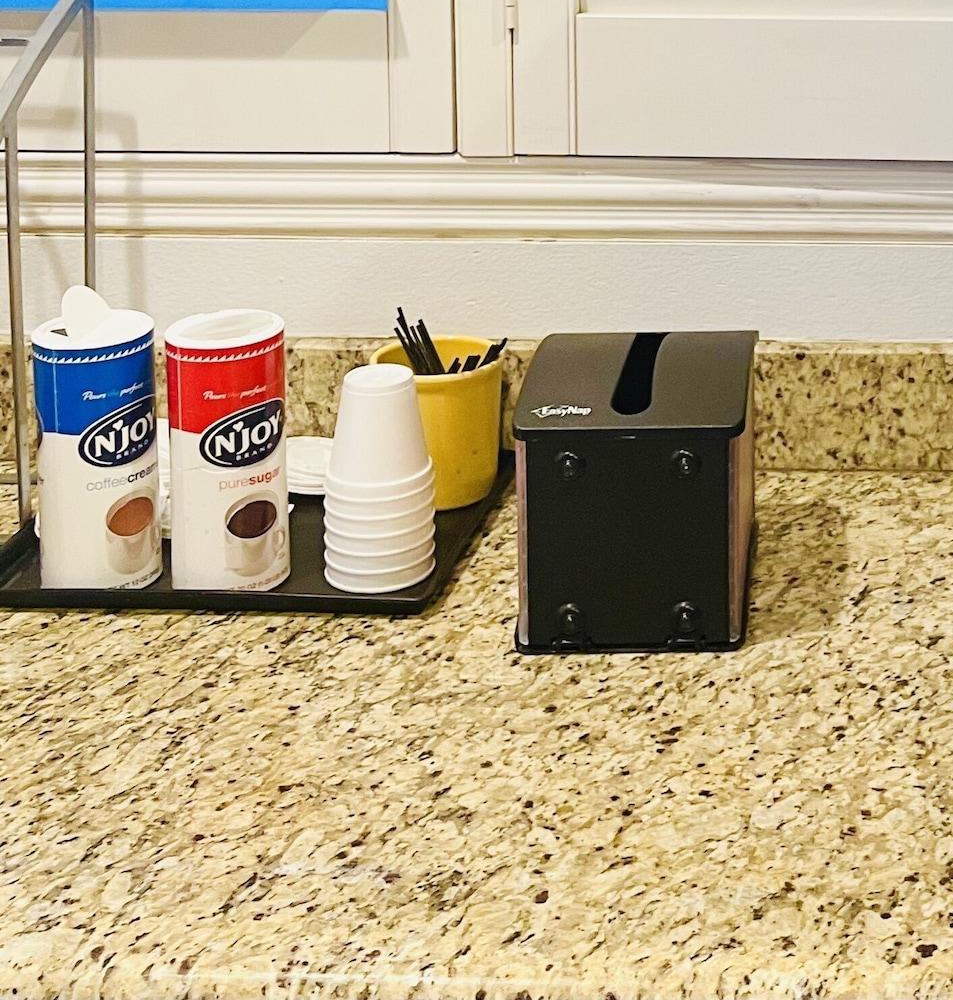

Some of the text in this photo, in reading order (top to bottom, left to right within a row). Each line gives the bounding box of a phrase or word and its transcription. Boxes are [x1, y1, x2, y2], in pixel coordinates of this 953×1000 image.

[82, 390, 107, 401] Pours
[120, 382, 144, 397] perfect
[203, 390, 227, 401] Pours
[240, 385, 267, 399] perfect
[541, 405, 592, 416] EasyNap
